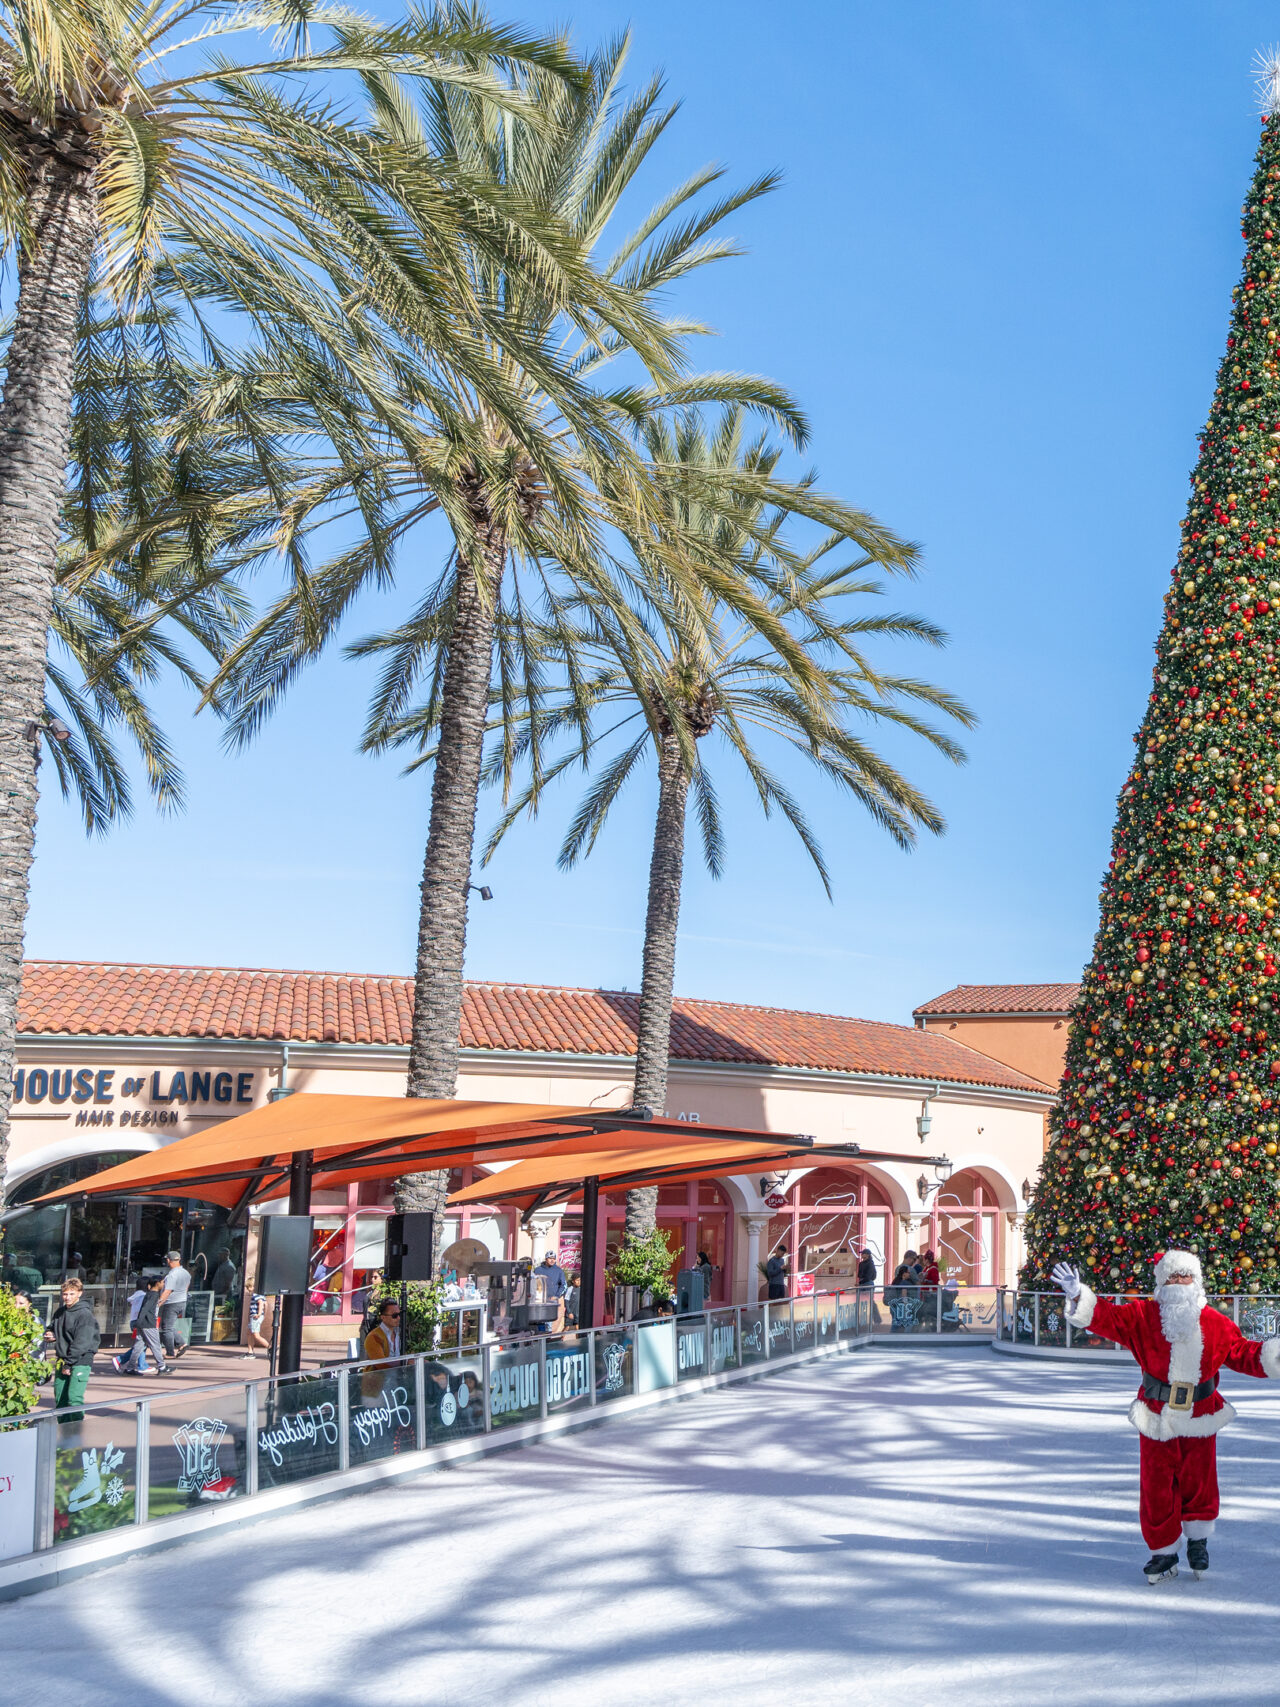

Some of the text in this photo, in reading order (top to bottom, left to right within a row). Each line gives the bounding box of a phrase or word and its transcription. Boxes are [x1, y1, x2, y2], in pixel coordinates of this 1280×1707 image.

[152, 1070, 254, 1102] LANGE
[78, 1110, 179, 1124] HAIR DESIGN
